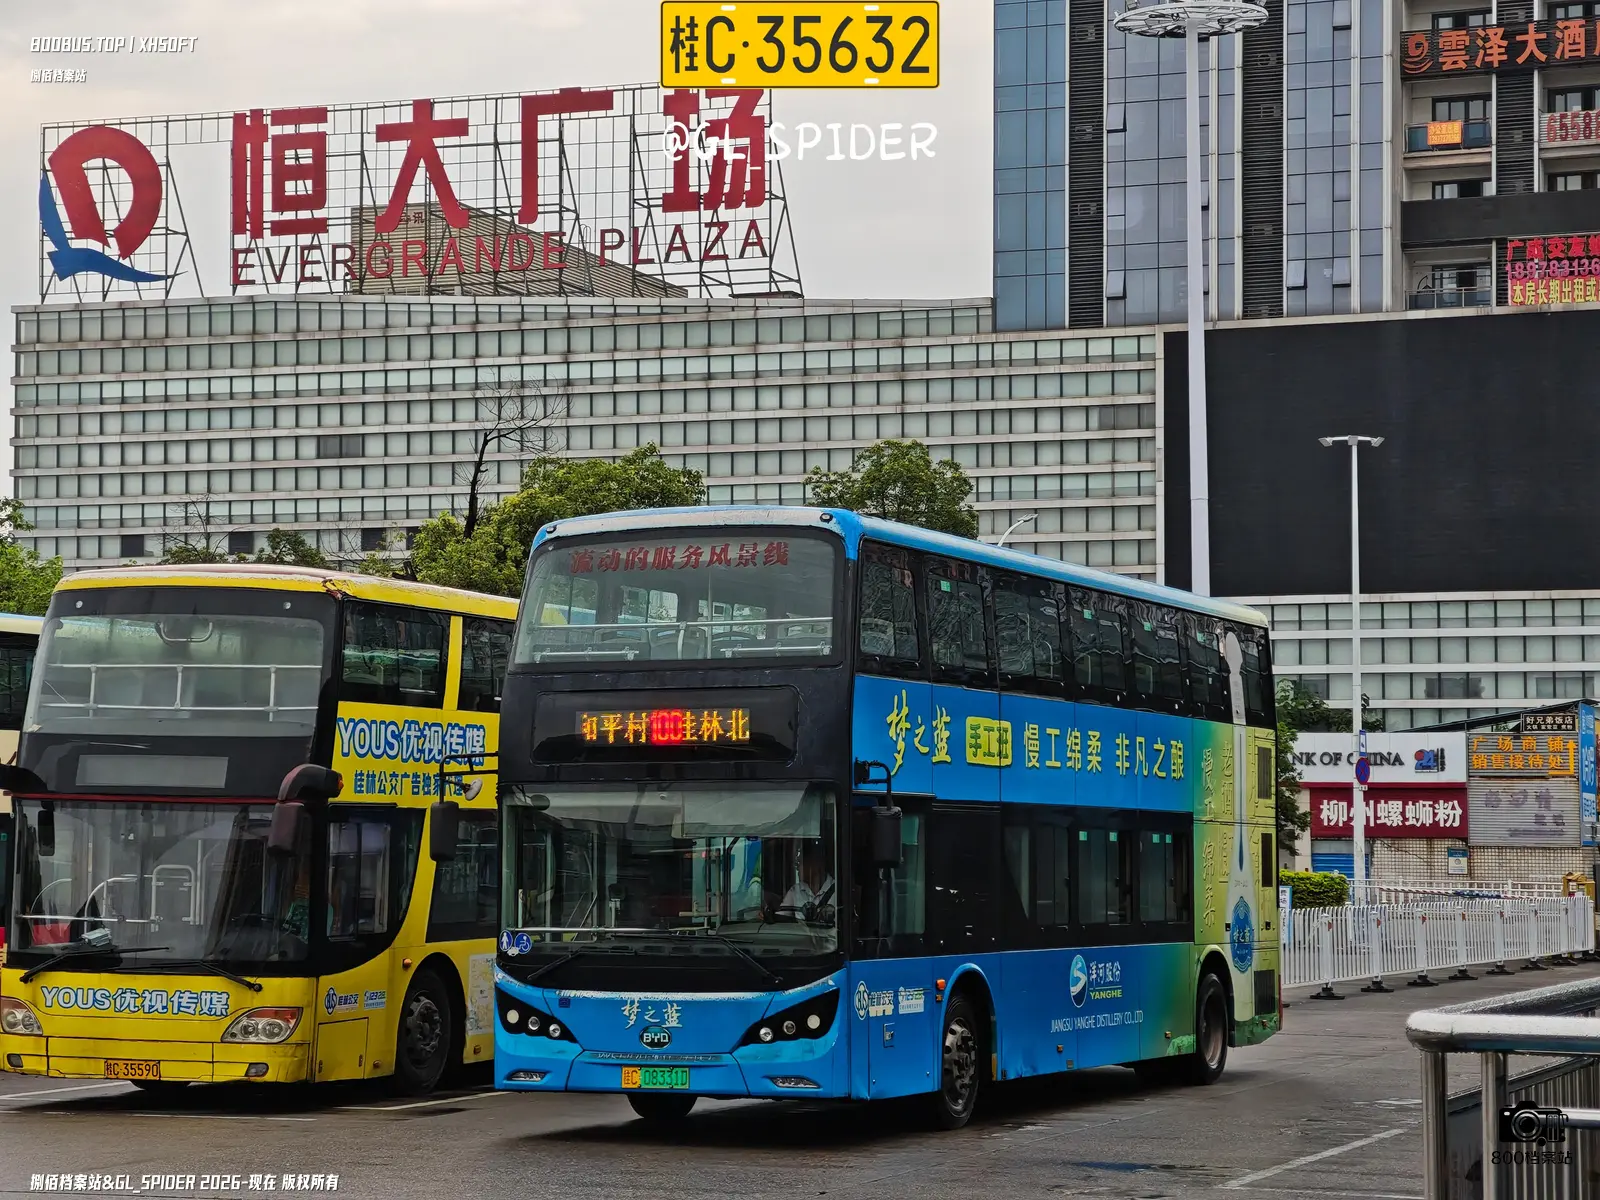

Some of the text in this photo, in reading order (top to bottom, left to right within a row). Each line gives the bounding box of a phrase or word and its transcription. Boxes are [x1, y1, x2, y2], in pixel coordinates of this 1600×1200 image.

[1438, 19, 1600, 71] 雲泽大酒
[231, 87, 765, 239] 恒大广场
[231, 218, 768, 287] EVERGRANDE PLAZA
[1512, 277, 1600, 305] 本房长期出租或
[570, 541, 790, 574] 流动的服务风景线
[650, 709, 683, 743] 100
[336, 717, 486, 767] YOUS优视传媒
[1023, 721, 1102, 773] 慢工绵柔
[1115, 732, 1185, 781] 非凡之酿
[1473, 736, 1564, 753] 广场商铺
[1292, 752, 1317, 766] NK
[1320, 752, 1343, 766] OF
[1472, 754, 1565, 770] 销售接待处
[1320, 800, 1462, 828] 柳州螺蛳粉
[1089, 961, 1121, 986] 洋河股份
[41, 986, 230, 1016] YOUS优视传媒
[1090, 989, 1123, 1000] YANGHE
[621, 1000, 683, 1029] 梦之蓝
[1050, 1019, 1074, 1033] JIANGSU
[1074, 1016, 1095, 1029] YANGHE
[1097, 1012, 1123, 1027] DISTILLERY
[643, 1033, 669, 1042] BYD
